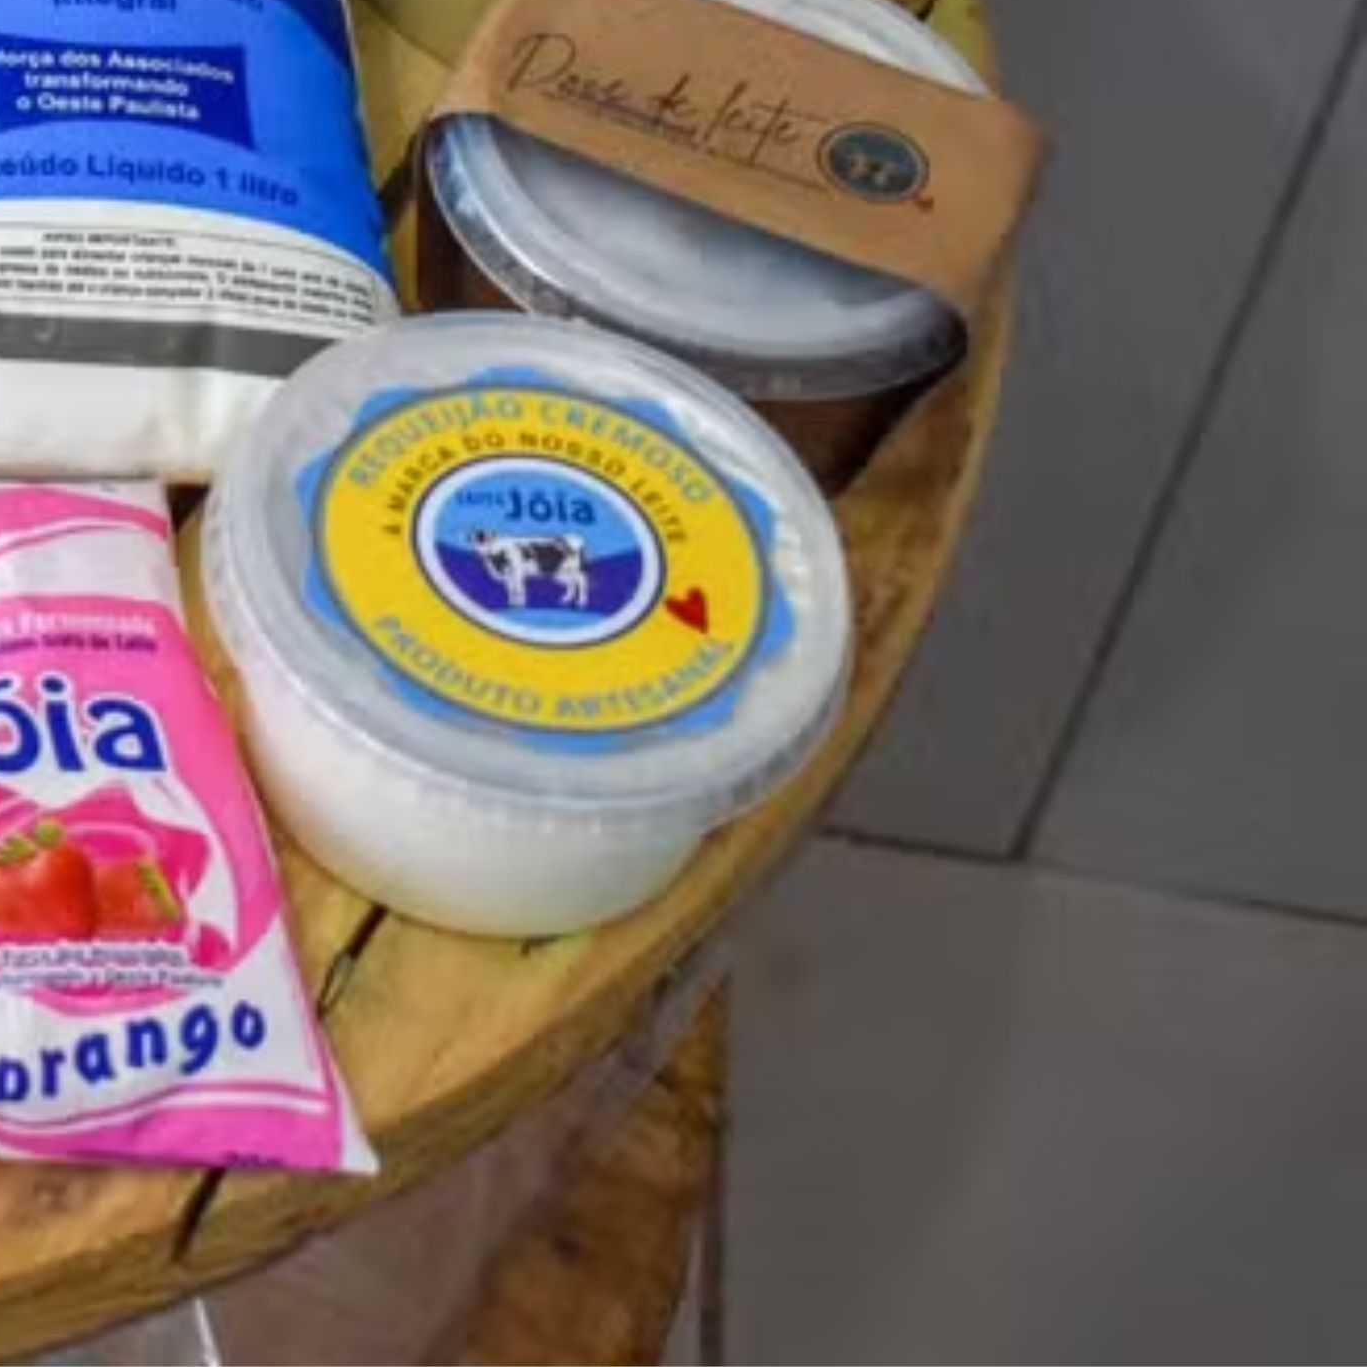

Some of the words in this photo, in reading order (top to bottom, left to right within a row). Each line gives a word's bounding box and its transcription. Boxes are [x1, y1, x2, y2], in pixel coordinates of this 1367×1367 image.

[23, 70, 190, 98] transformando
[60, 49, 102, 69] dos
[106, 49, 235, 84] Associados
[15, 94, 33, 111] o
[36, 91, 104, 113] Oeste
[107, 94, 201, 121] Paulista
[86, 152, 206, 187] Líquido
[214, 167, 230, 193] 1
[238, 167, 301, 207] litro
[539, 398, 713, 504] CREMOSO
[387, 447, 459, 513] MARCA
[460, 432, 506, 451] DO
[517, 431, 628, 477] NOSSO
[629, 478, 688, 543] LEITE
[504, 485, 597, 525] Jóia
[373, 613, 543, 717] PRODUTO
[554, 636, 737, 719] ARTESANAL
